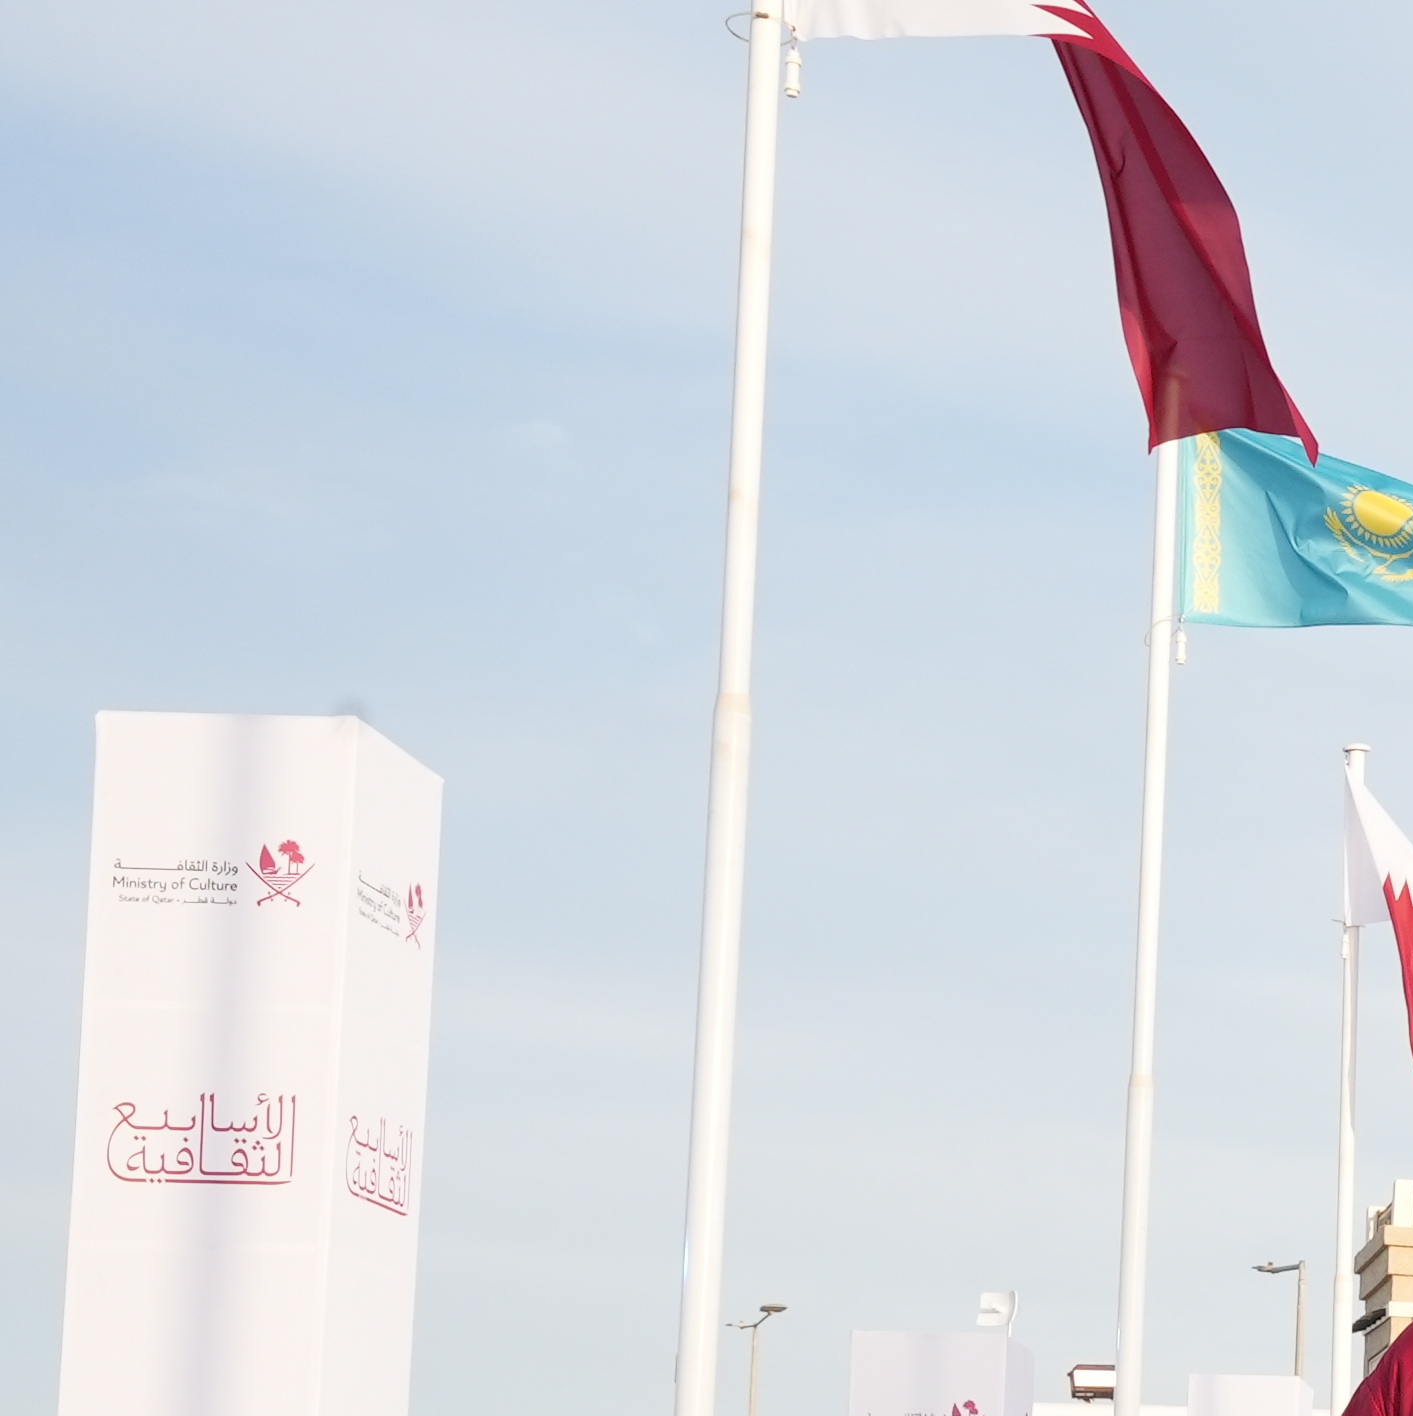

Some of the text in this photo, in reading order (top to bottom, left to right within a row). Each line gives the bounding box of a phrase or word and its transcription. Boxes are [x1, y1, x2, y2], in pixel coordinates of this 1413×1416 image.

[211, 860, 239, 876] وزارة
[112, 875, 238, 892] Ministry of Culture
